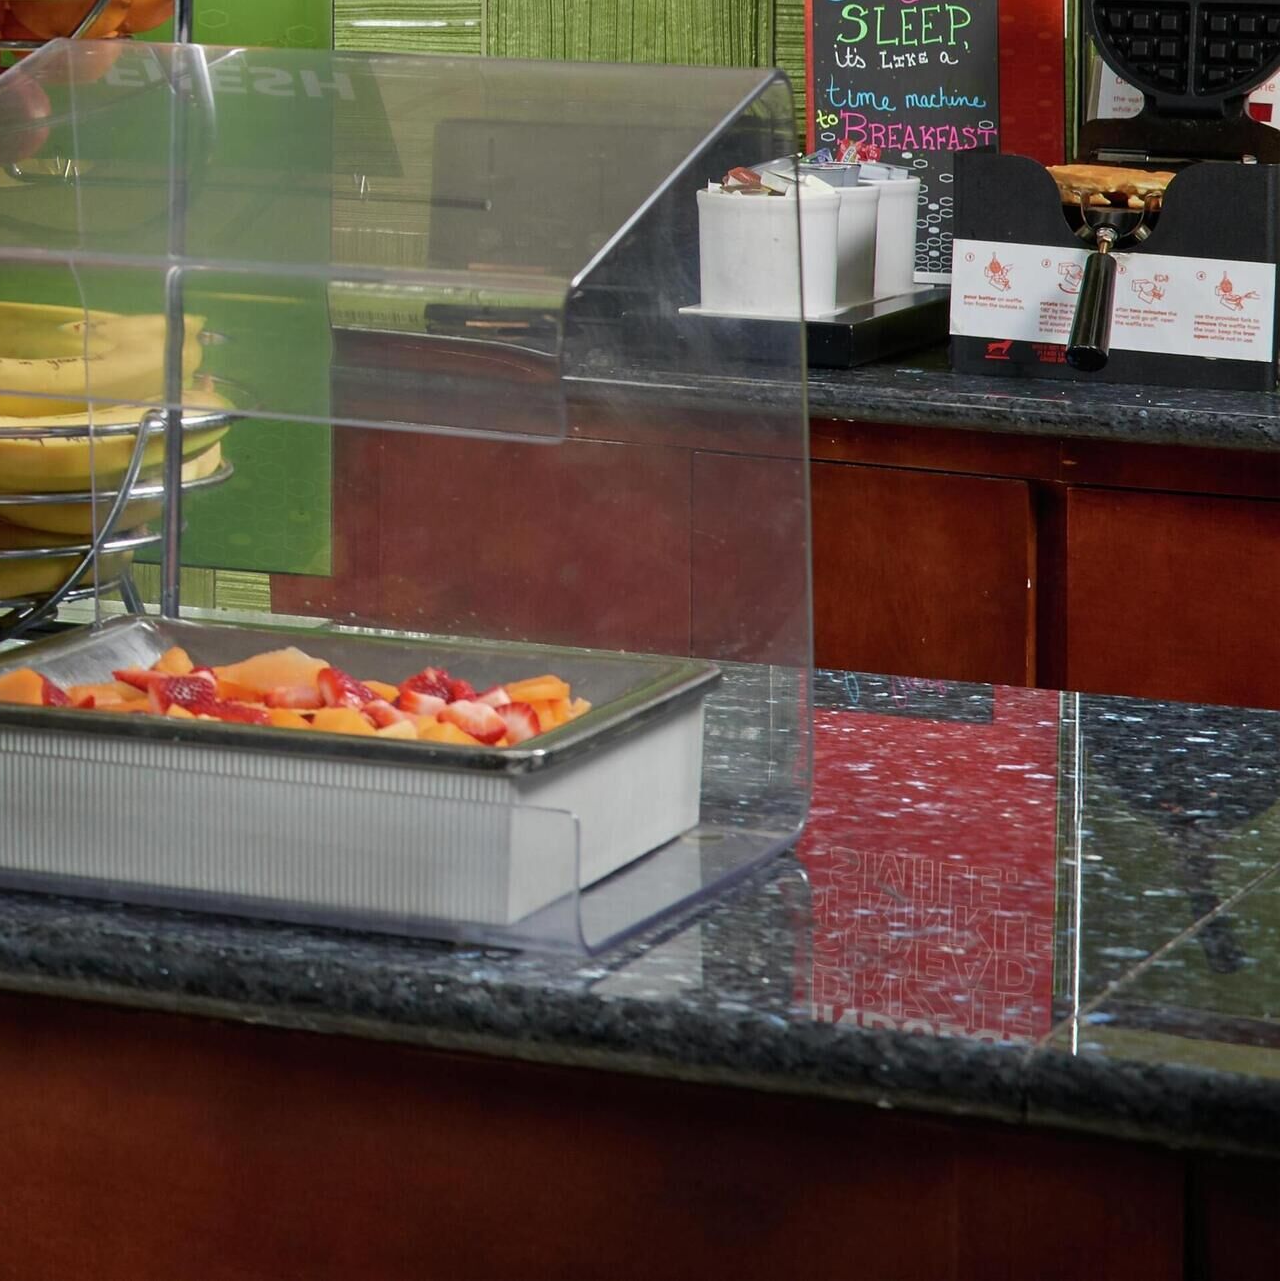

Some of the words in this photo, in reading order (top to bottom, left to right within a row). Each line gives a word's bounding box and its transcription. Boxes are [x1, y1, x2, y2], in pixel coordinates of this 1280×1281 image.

[834, 44, 866, 69] it's
[940, 51, 958, 65] a
[826, 74, 896, 112] time
[905, 87, 986, 109] machine
[816, 109, 838, 129] to
[837, 110, 997, 151] BREAKFAST
